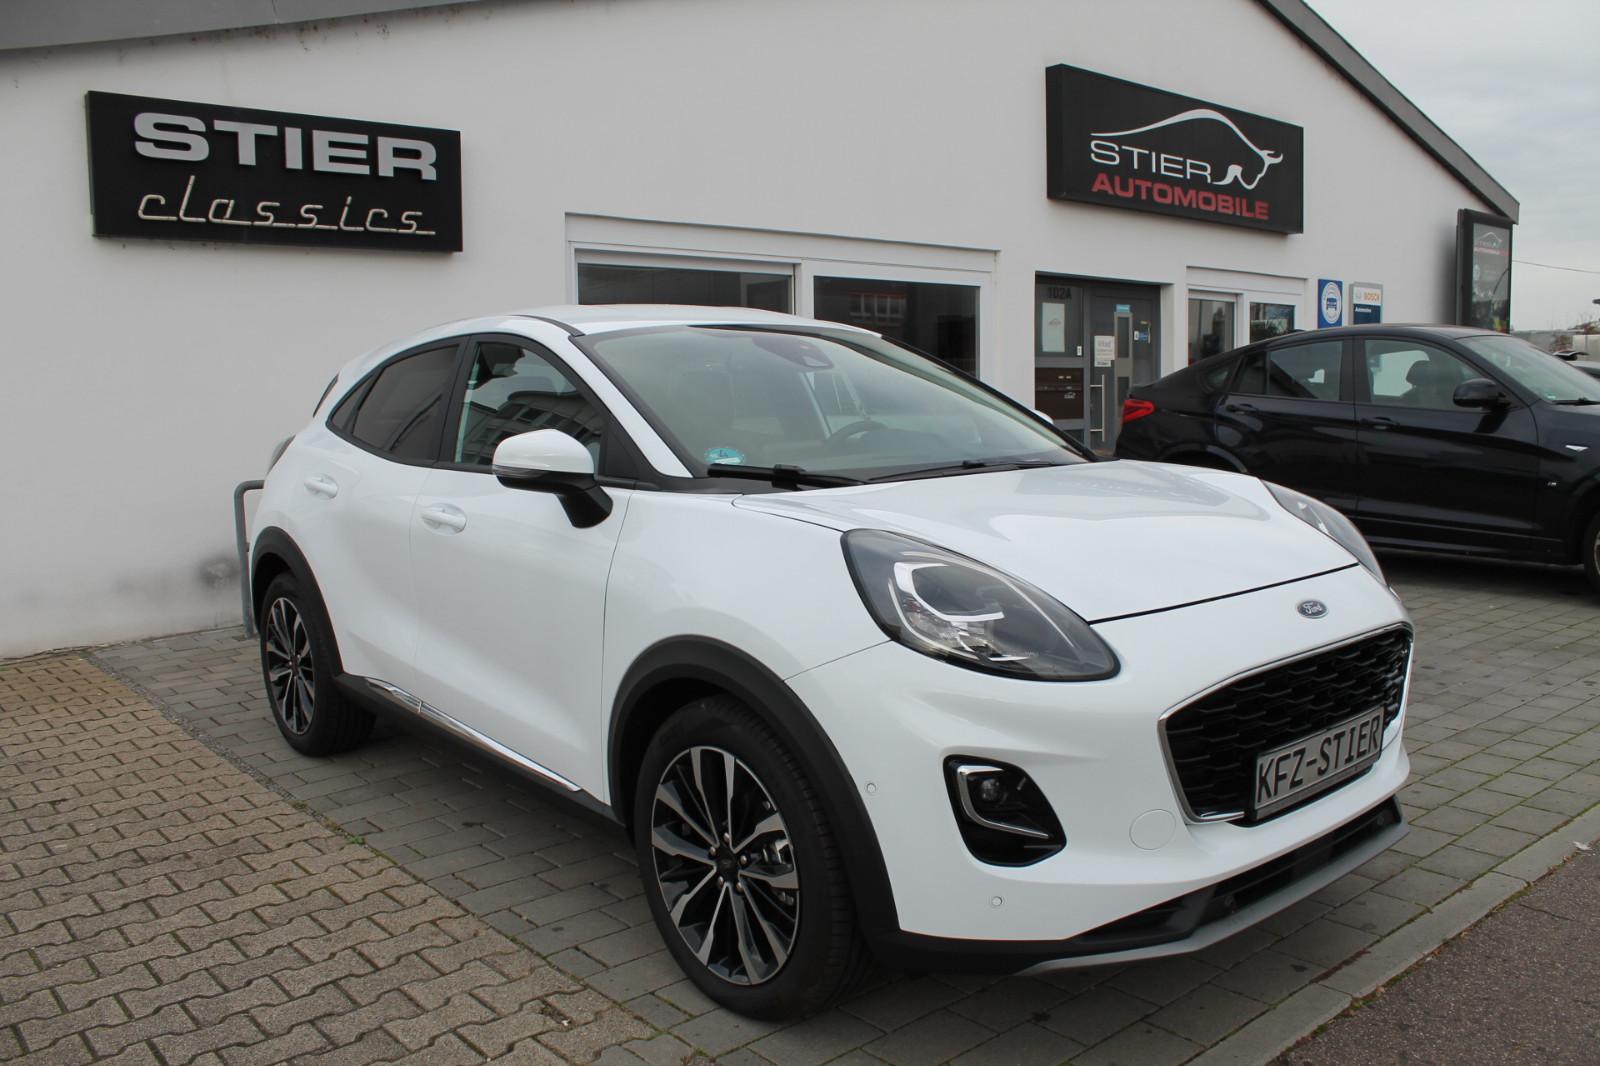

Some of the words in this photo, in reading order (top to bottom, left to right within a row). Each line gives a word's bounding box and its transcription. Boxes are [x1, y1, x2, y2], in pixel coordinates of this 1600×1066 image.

[134, 112, 437, 181] STIER
[1090, 140, 1212, 184] STIER
[137, 175, 436, 236] classics
[1091, 172, 1270, 220] AUTOMOBILE
[1256, 714, 1381, 804] KFZ-STIER
